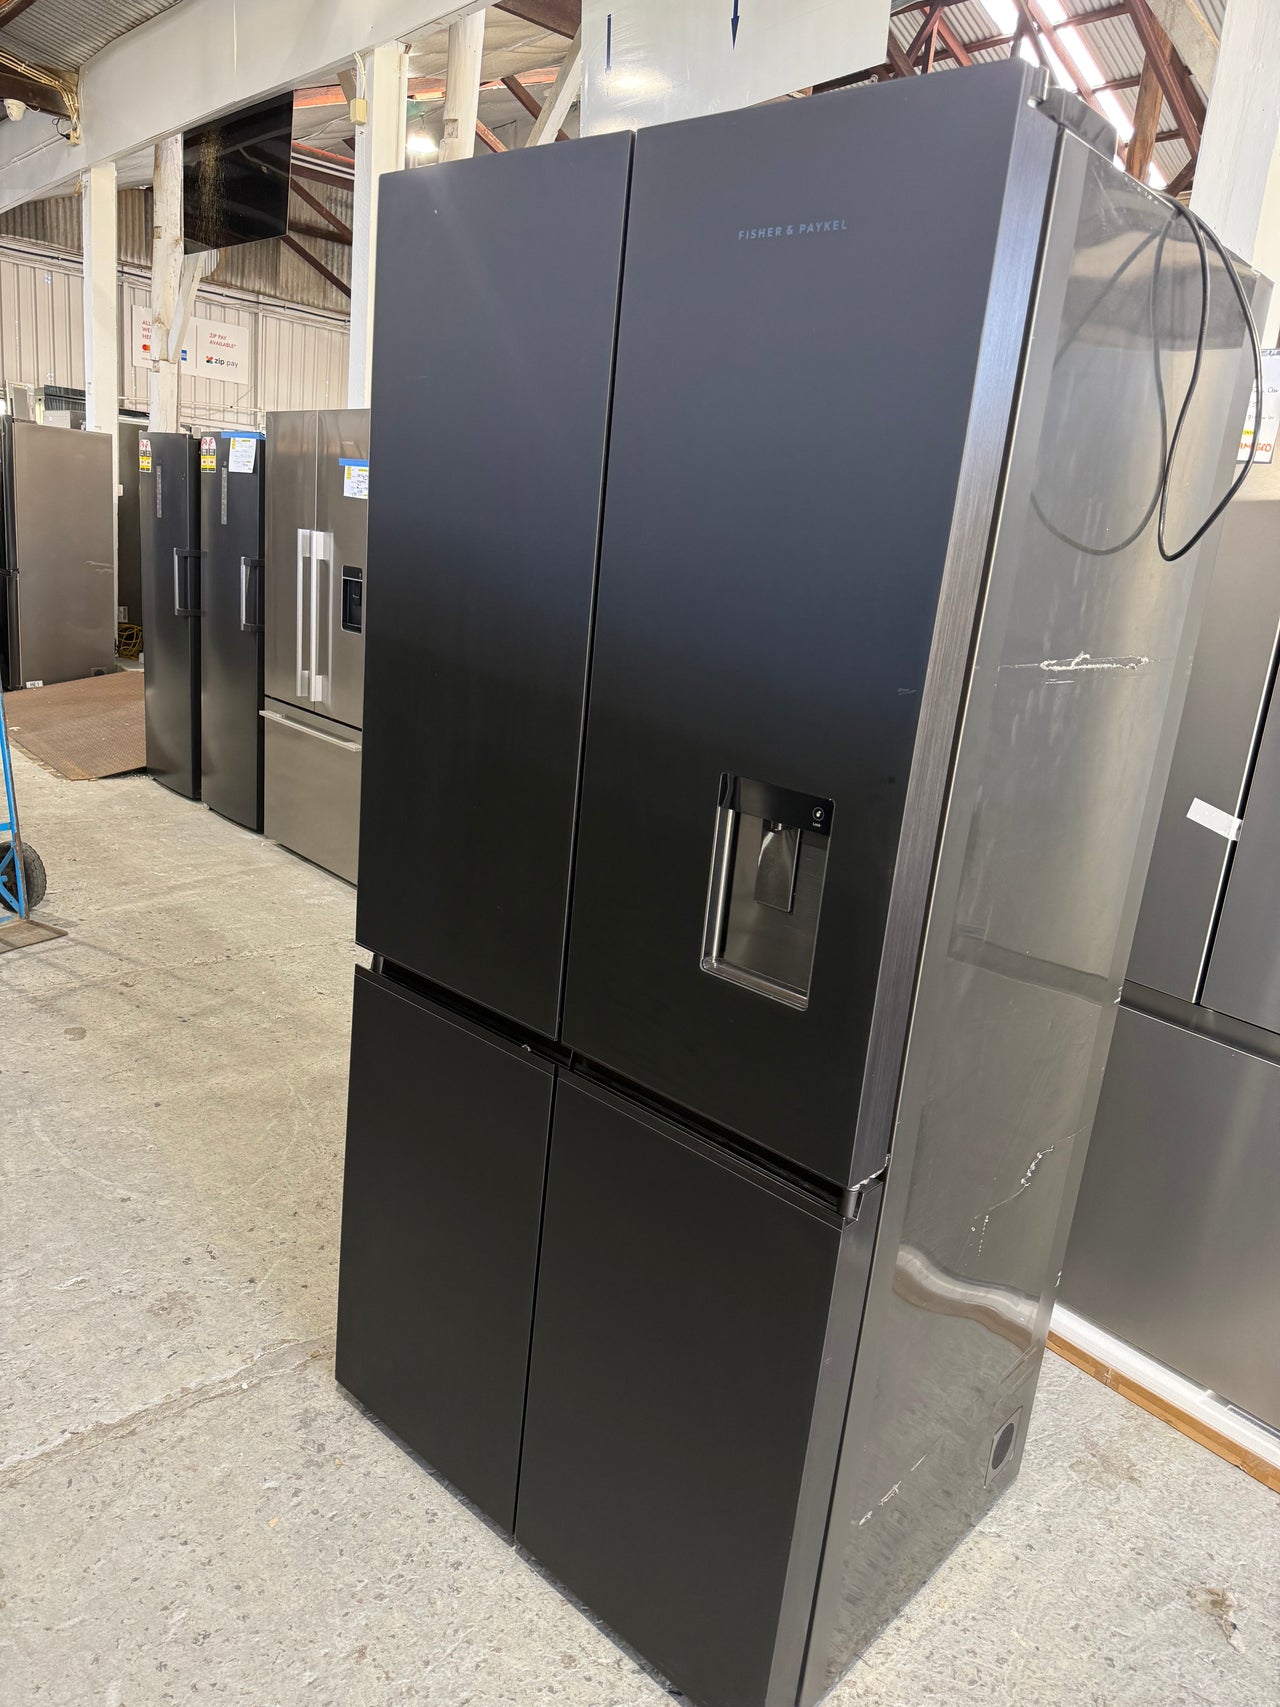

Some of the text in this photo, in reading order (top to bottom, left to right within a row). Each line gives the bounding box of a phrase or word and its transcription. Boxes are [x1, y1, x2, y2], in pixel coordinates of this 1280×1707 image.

[738, 219, 848, 240] FISHER & PAYKEL
[214, 357, 225, 366] zip
